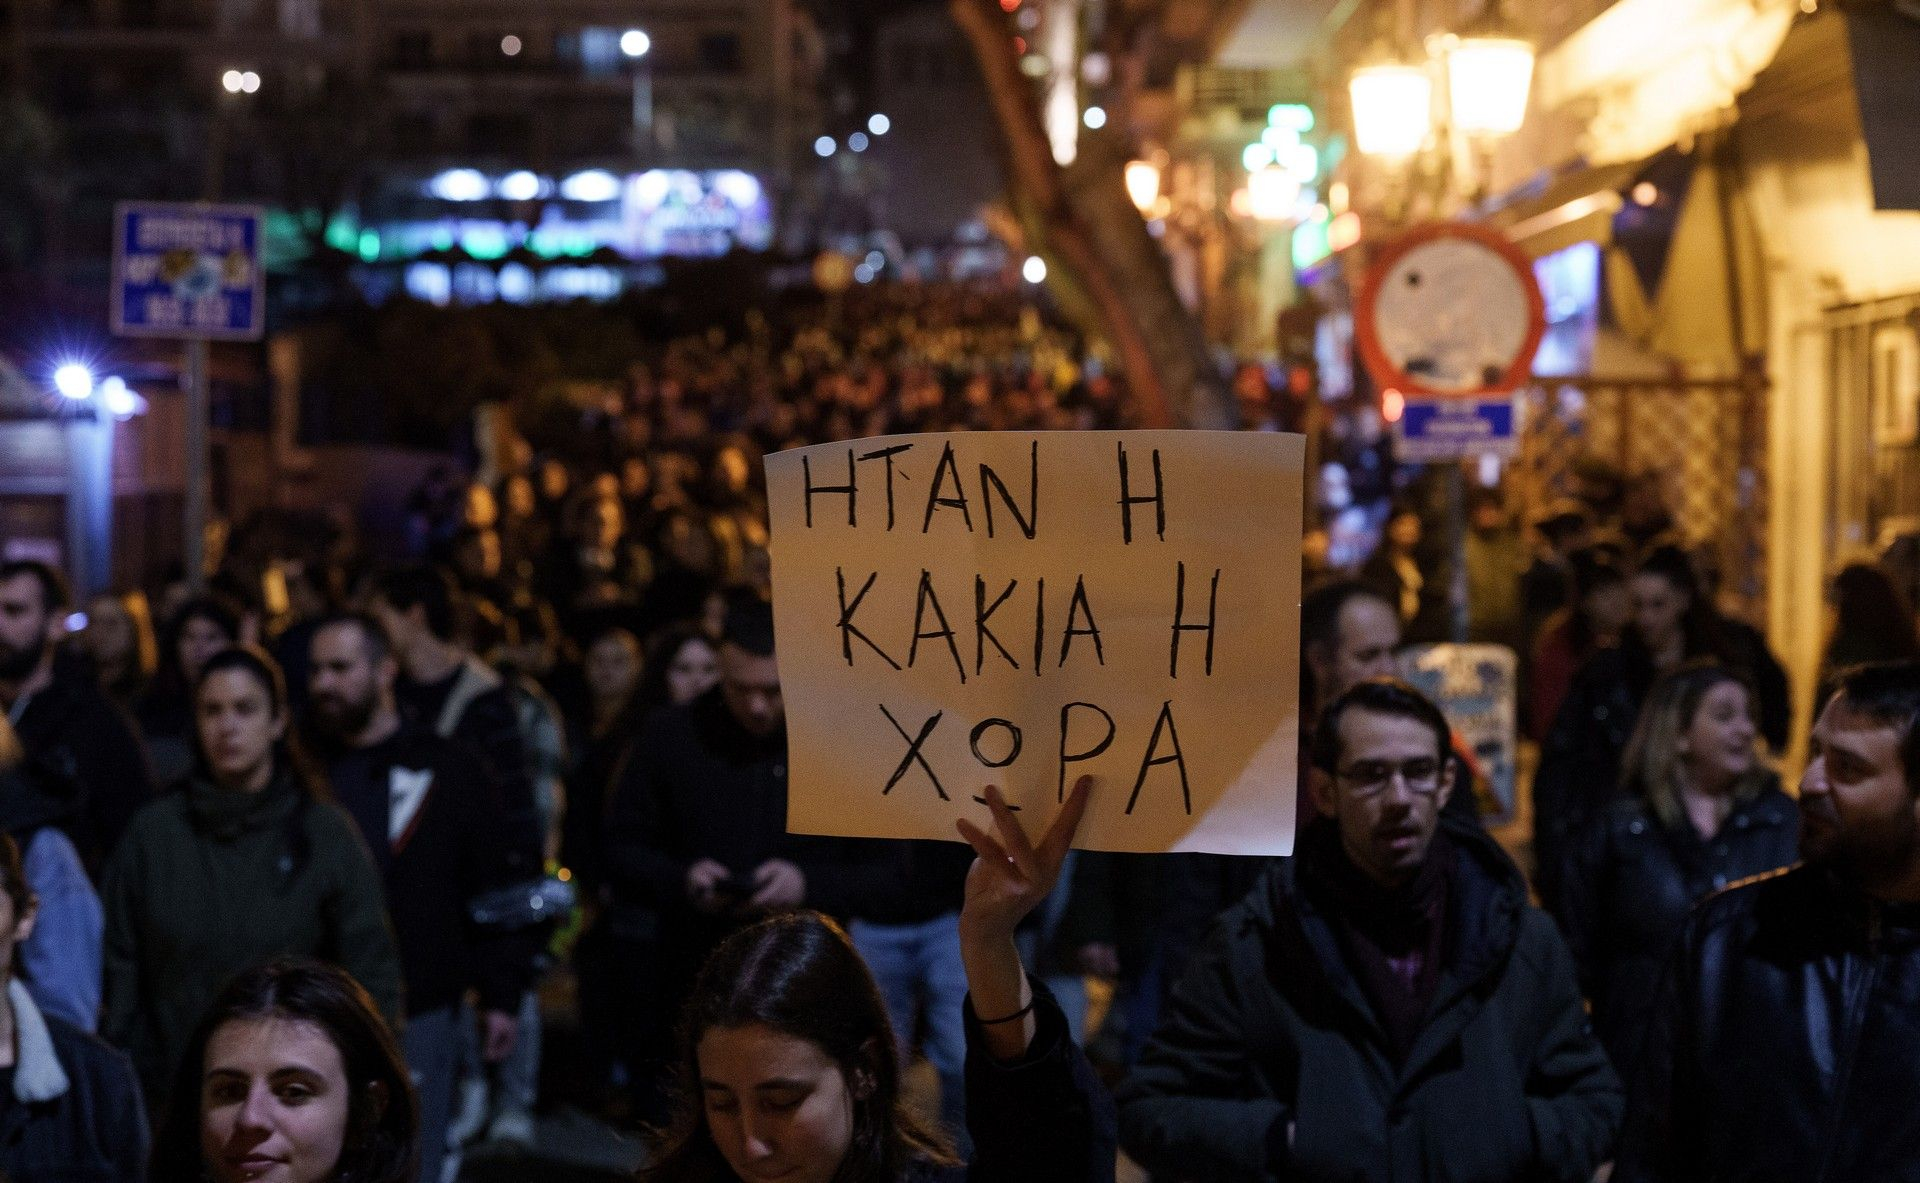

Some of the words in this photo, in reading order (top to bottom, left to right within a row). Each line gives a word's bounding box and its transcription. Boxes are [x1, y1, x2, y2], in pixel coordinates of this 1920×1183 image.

[802, 440, 1037, 539] ΗΤΑΝ
[1116, 440, 1165, 545] Η
[836, 566, 1105, 684] ΚΑΚΙΑ
[1171, 560, 1221, 679] Η
